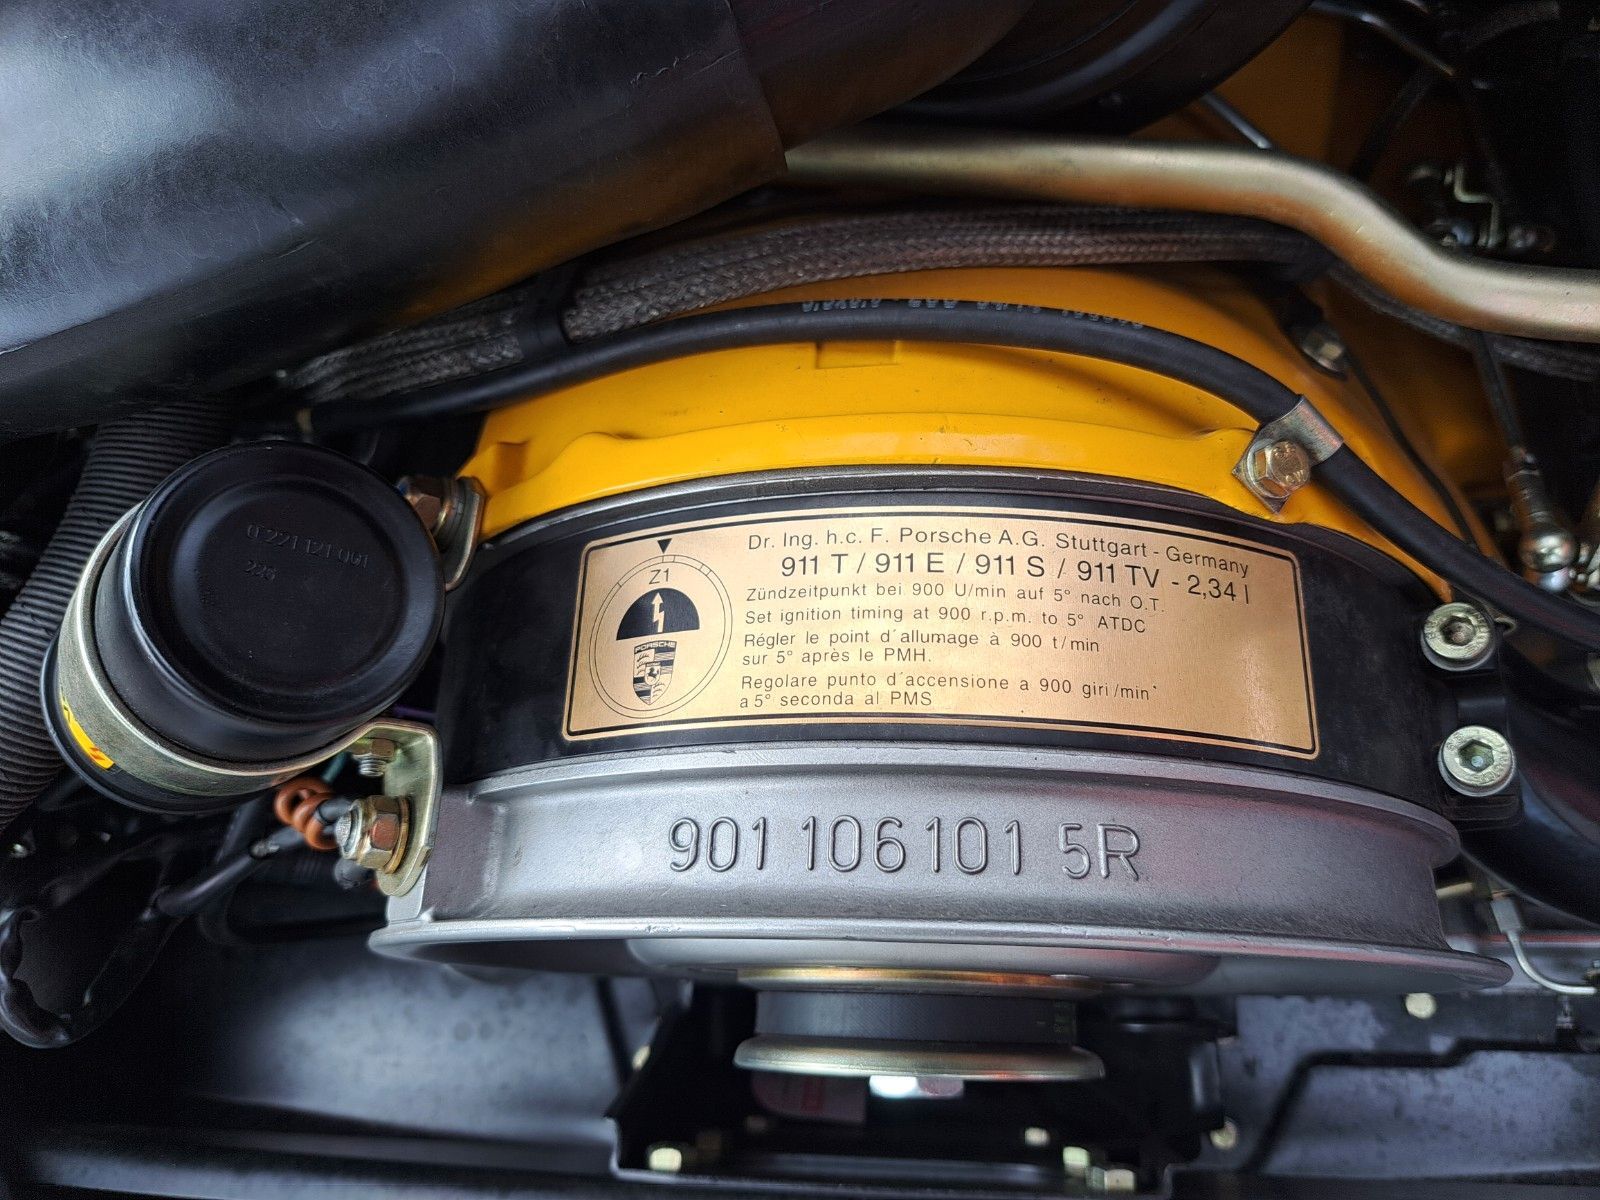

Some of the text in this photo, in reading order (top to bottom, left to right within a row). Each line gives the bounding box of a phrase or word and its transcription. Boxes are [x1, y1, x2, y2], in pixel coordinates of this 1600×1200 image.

[749, 534, 775, 549] Dr.
[784, 533, 818, 549] Ing.
[827, 530, 861, 544] h.c.
[871, 528, 889, 543] F.
[901, 527, 991, 543] Porsche
[998, 529, 1045, 547] A.G.
[1056, 533, 1147, 557] Stuttgart
[1166, 545, 1249, 578] Germany
[649, 568, 670, 585] Z1
[782, 556, 818, 576] 911
[831, 554, 848, 573] T
[875, 553, 914, 573] 911
[927, 552, 944, 573] E
[975, 554, 1014, 575] 911
[1027, 555, 1045, 577] S
[1077, 560, 1115, 583] 911
[1125, 565, 1160, 588] TV
[1187, 575, 1236, 601] 2,34
[747, 583, 1165, 612] Zündzeitpunkt bei 900 U/min auf 5° nach O.T.
[745, 606, 1146, 633] Set ignition timing at 900 r.p.m. to 5° ATDC
[634, 640, 677, 653] PORSCHE
[744, 632, 796, 650] Régler
[806, 631, 819, 644] le
[830, 630, 870, 647] point
[990, 632, 999, 646] à
[1011, 633, 1042, 648] 900
[743, 648, 931, 666] sur 5° après le PMH.
[741, 674, 818, 692] Regolare
[828, 673, 876, 688] punto
[1019, 681, 1029, 691] a
[1040, 679, 1072, 694] 900
[740, 696, 748, 708] a
[780, 692, 854, 707] seconda
[865, 692, 879, 704] al
[891, 692, 932, 706] PMS
[669, 814, 1141, 882] 901 106 101 5R
